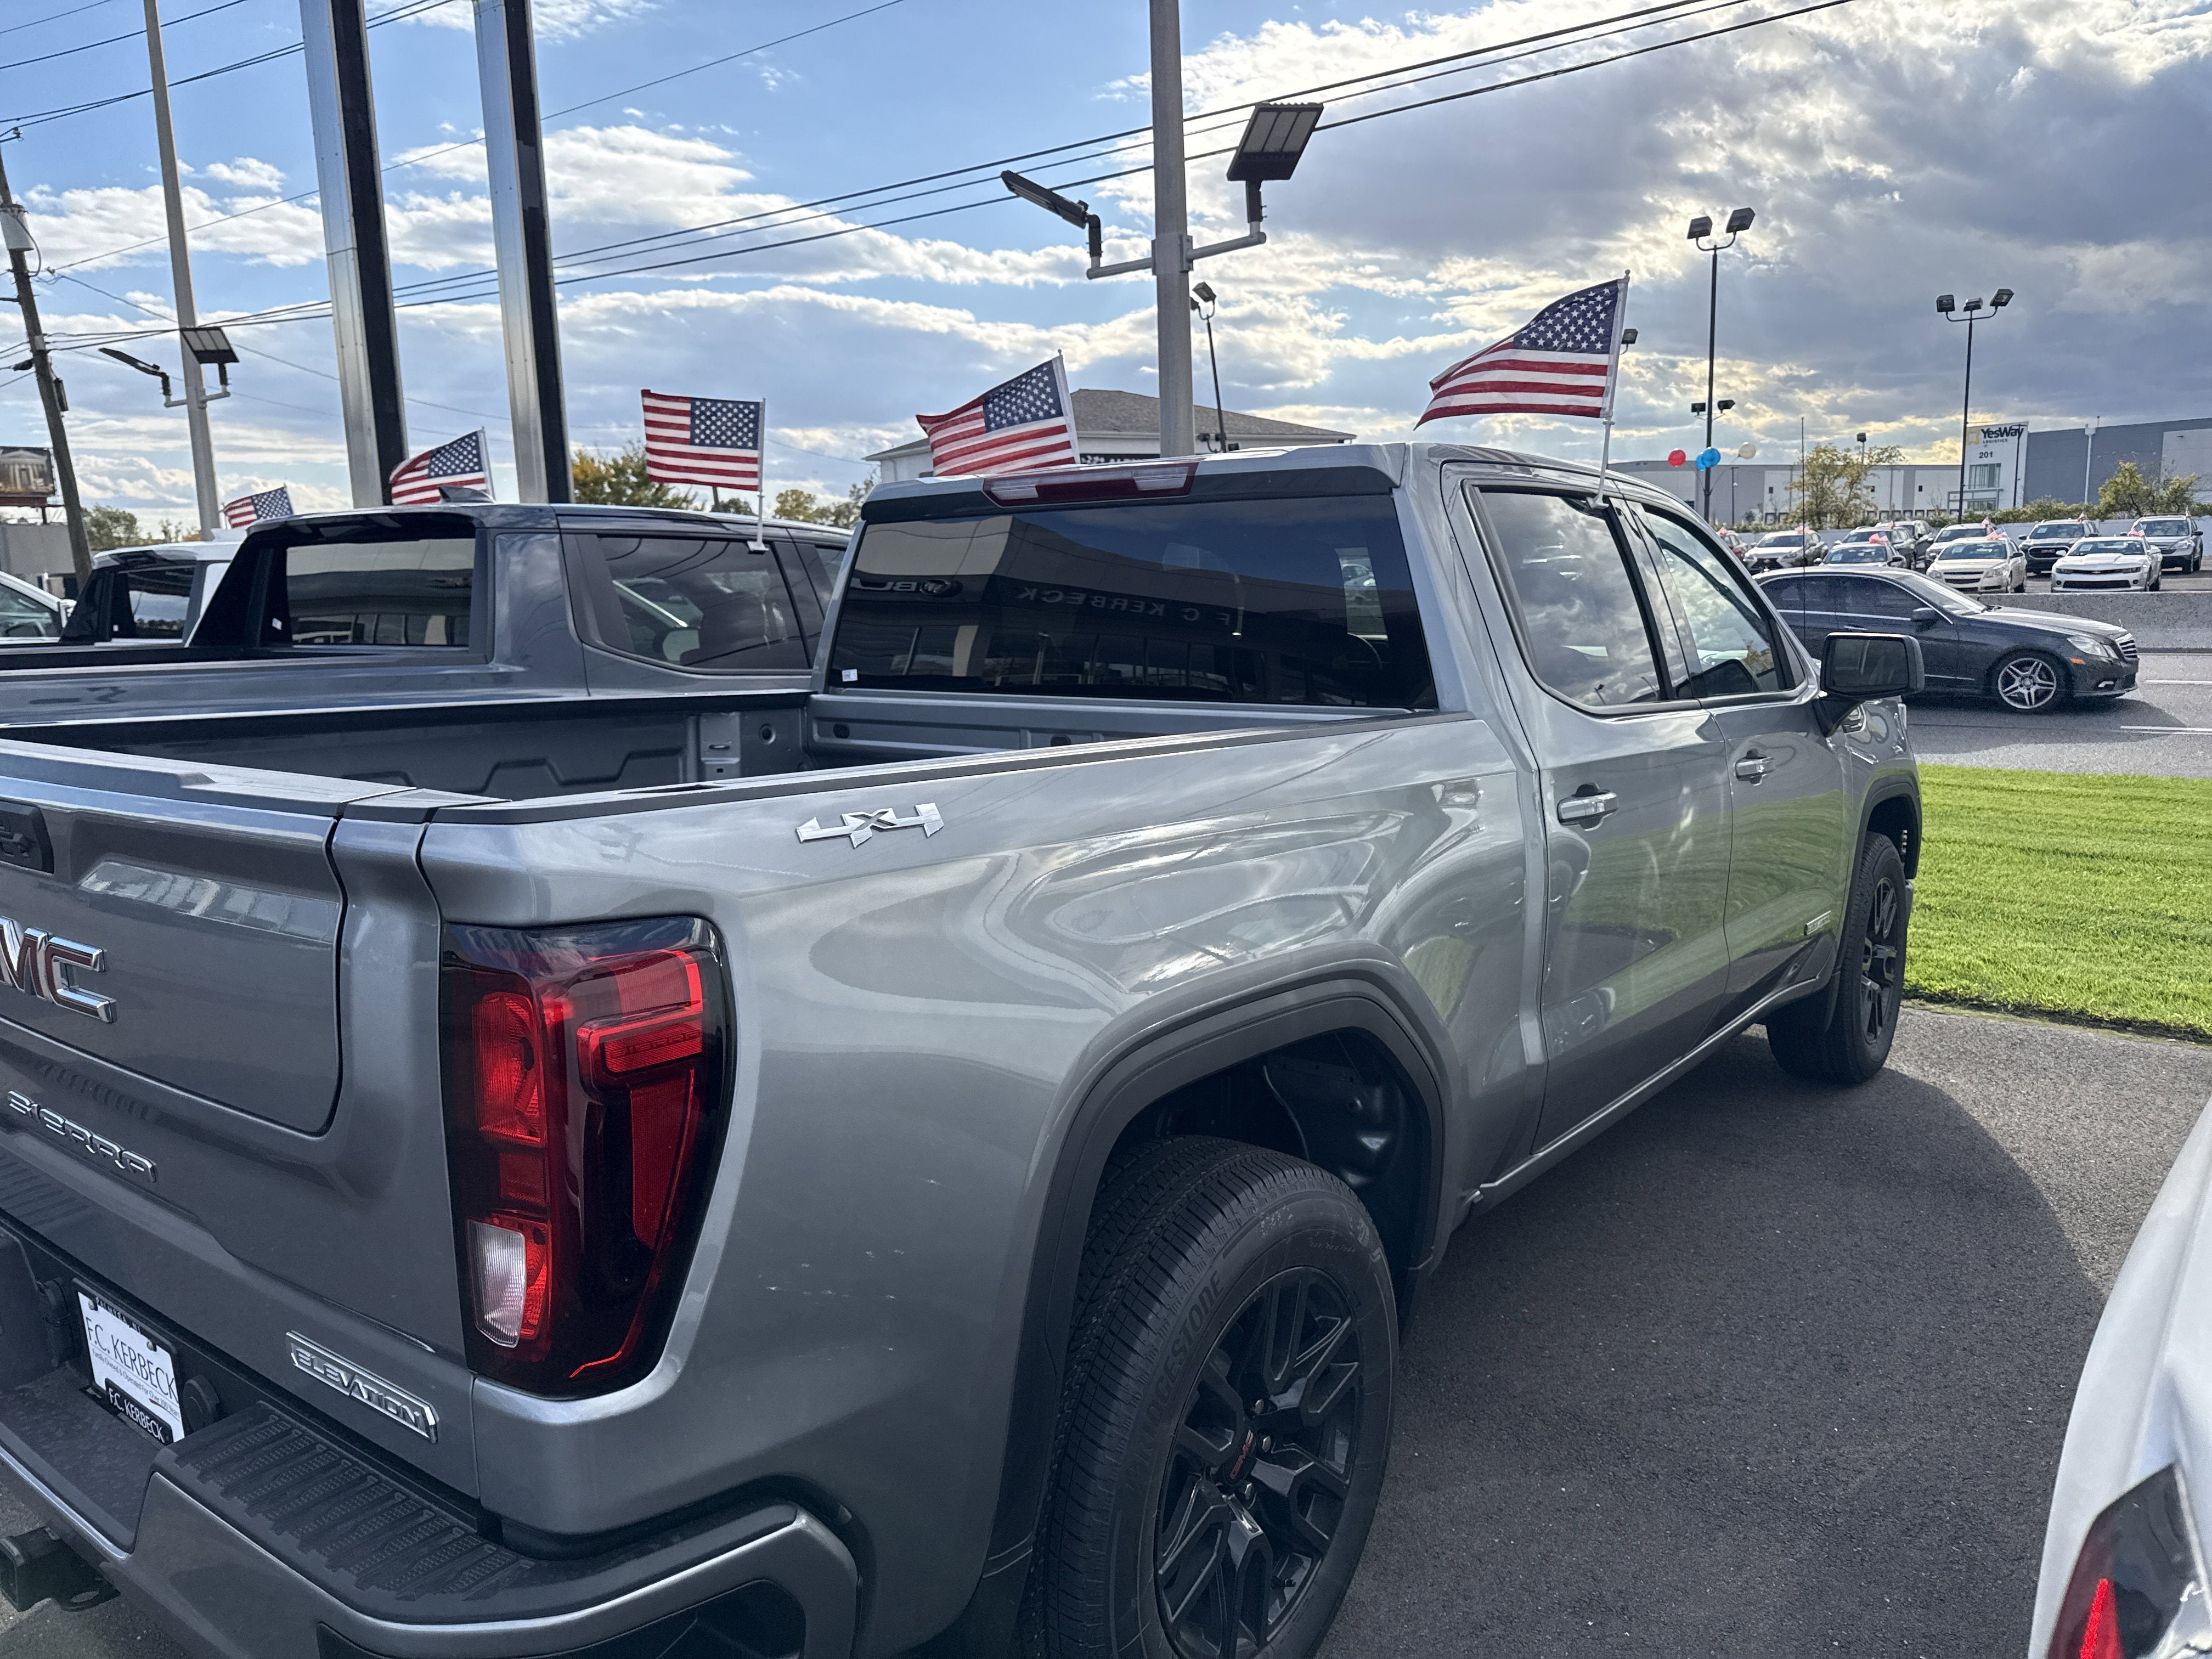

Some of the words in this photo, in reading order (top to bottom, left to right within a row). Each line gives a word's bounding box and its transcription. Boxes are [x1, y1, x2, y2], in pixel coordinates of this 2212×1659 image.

[1980, 426, 2024, 439] YesWay
[8, 1090, 158, 1183] SIERRA
[111, 1334, 179, 1403] KERBECK
[295, 1346, 426, 1431] ELEVATION
[124, 1398, 165, 1443] KERBECK
[1229, 1429, 1254, 1480] GMC
